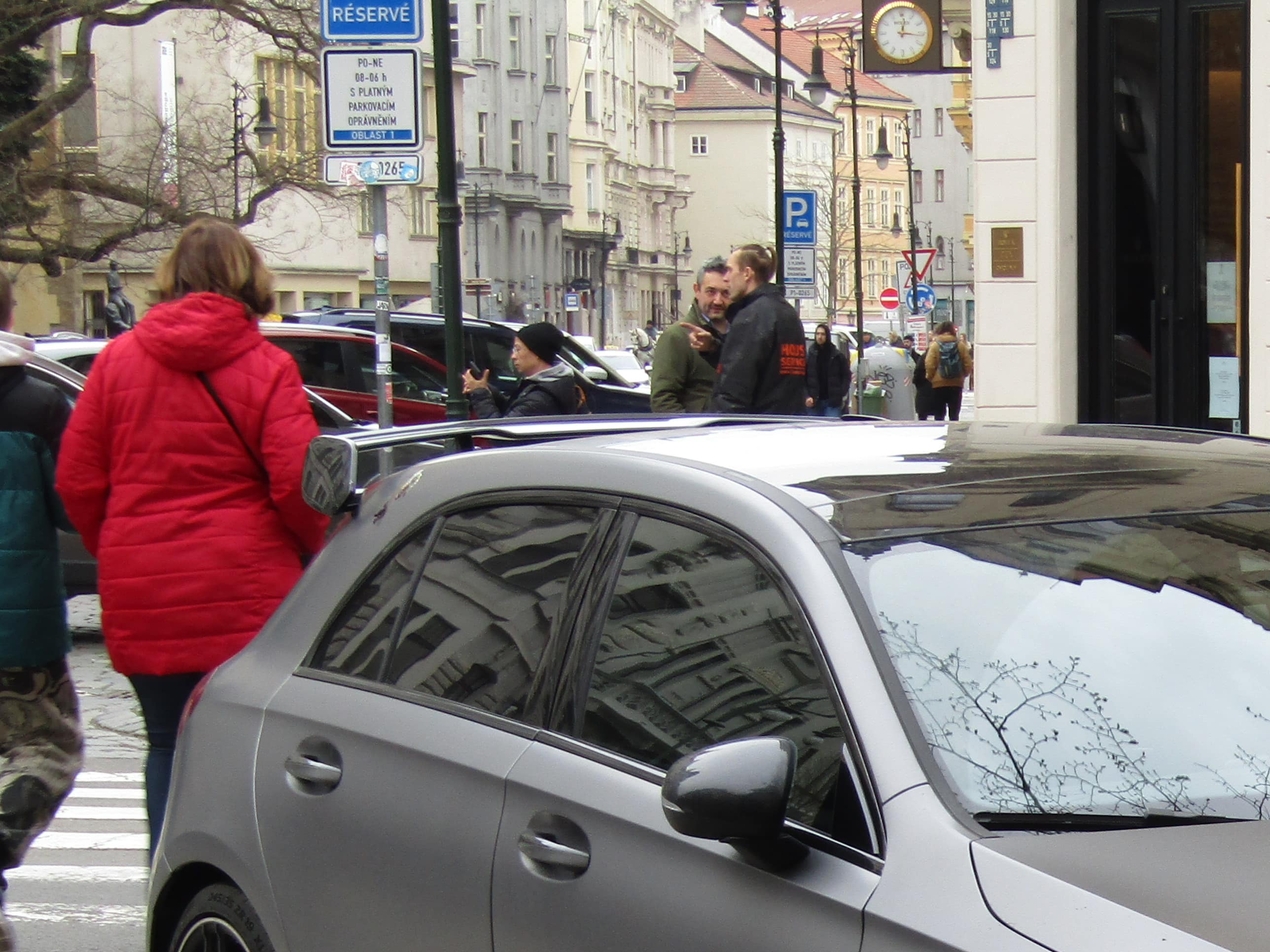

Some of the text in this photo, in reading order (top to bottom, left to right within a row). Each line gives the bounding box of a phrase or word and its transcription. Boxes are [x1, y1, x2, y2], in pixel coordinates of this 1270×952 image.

[332, 3, 411, 22] RÉSERVÉ
[357, 58, 384, 68] PO-NE
[355, 72, 388, 83] 08-06 h
[350, 85, 394, 97] S PLATNÝM
[348, 100, 396, 112] PARKOVACÍM
[347, 114, 398, 126] OPRÁVNĚNÍM
[351, 131, 395, 140] OBLAST 1
